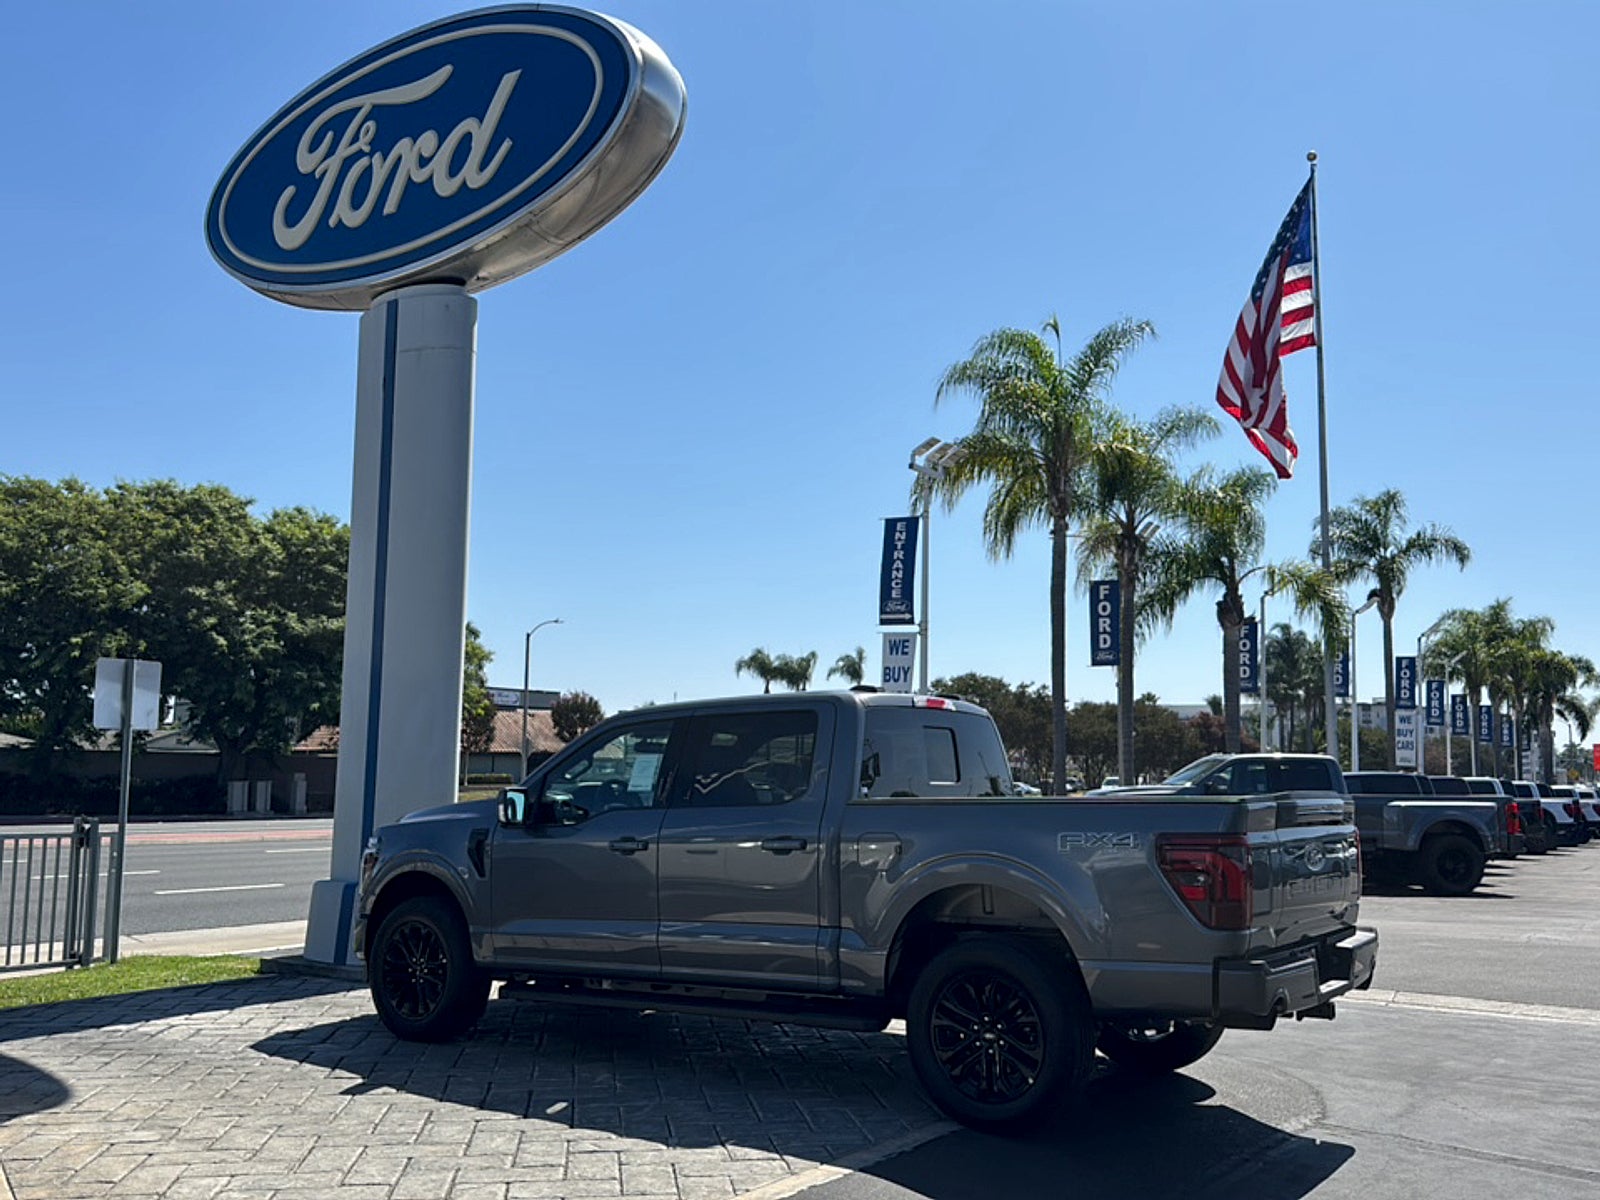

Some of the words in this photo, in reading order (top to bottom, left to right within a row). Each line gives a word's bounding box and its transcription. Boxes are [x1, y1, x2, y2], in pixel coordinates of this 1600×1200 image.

[272, 63, 522, 251] Ford
[891, 521, 907, 598] ENTRANCE
[1098, 584, 1112, 649] FORD
[888, 639, 910, 656] WE
[1239, 625, 1251, 678] FORD
[883, 667, 910, 683] BUY
[1400, 659, 1411, 699] FORD
[1431, 682, 1440, 717] FORD
[1397, 728, 1415, 738] BUY
[1398, 716, 1412, 725] WE
[1396, 740, 1415, 751] CARS
[1058, 832, 1138, 853] FX4
